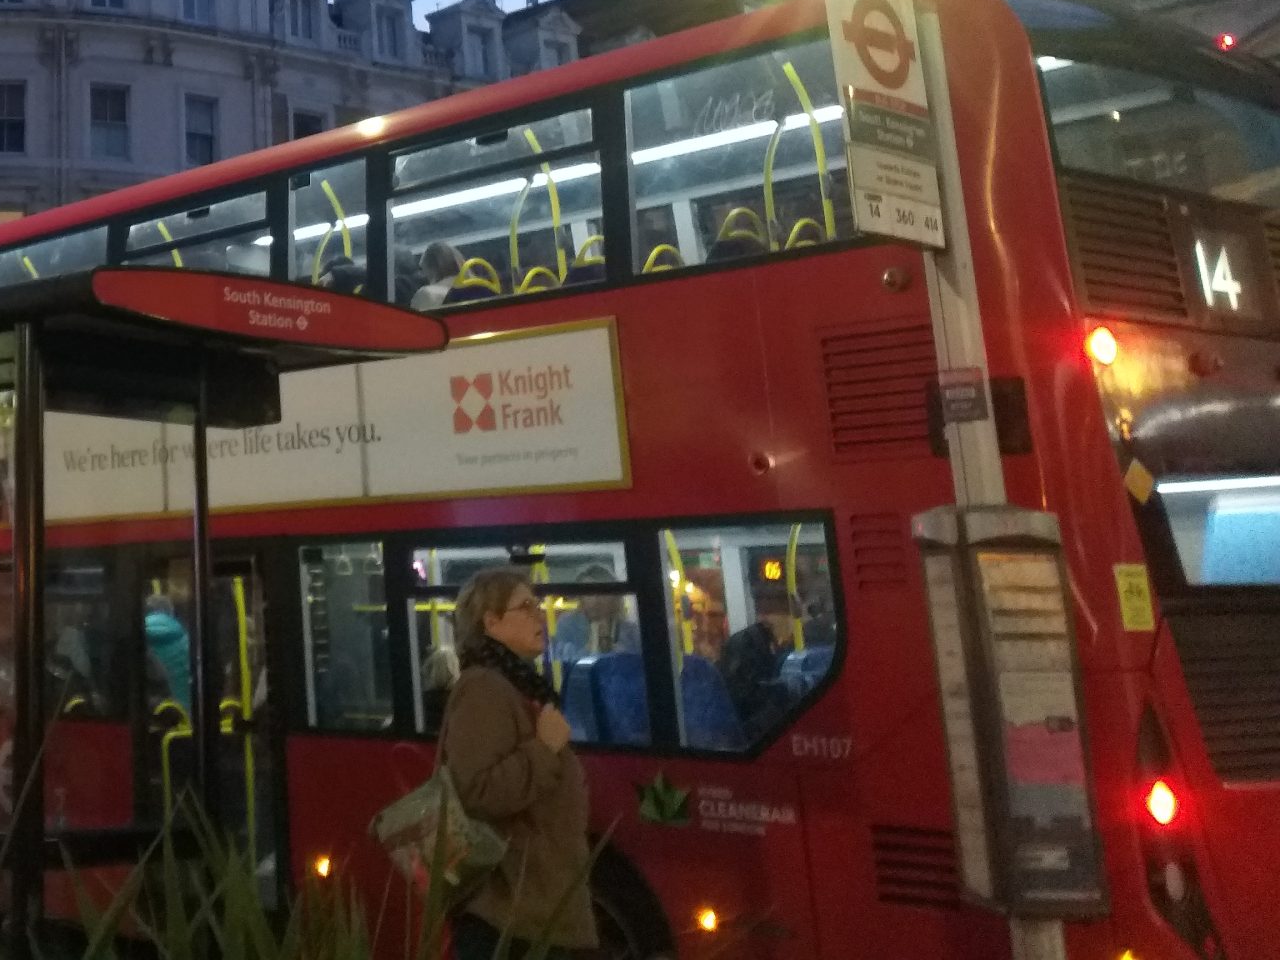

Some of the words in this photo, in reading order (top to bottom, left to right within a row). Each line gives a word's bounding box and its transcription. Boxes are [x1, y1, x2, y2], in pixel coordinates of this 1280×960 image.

[868, 202, 881, 219] 14
[895, 207, 915, 227] 360
[924, 216, 939, 232] 414
[1195, 239, 1241, 311] 14
[223, 286, 261, 306] South
[263, 291, 332, 315] Kensington
[248, 309, 293, 329] Station
[497, 364, 573, 400] Knight
[501, 399, 563, 431] Frank
[62, 447, 108, 473] We're
[110, 444, 149, 470] here
[152, 439, 178, 466] for
[241, 426, 271, 456] life
[276, 421, 331, 452] takes
[335, 423, 382, 455] you.
